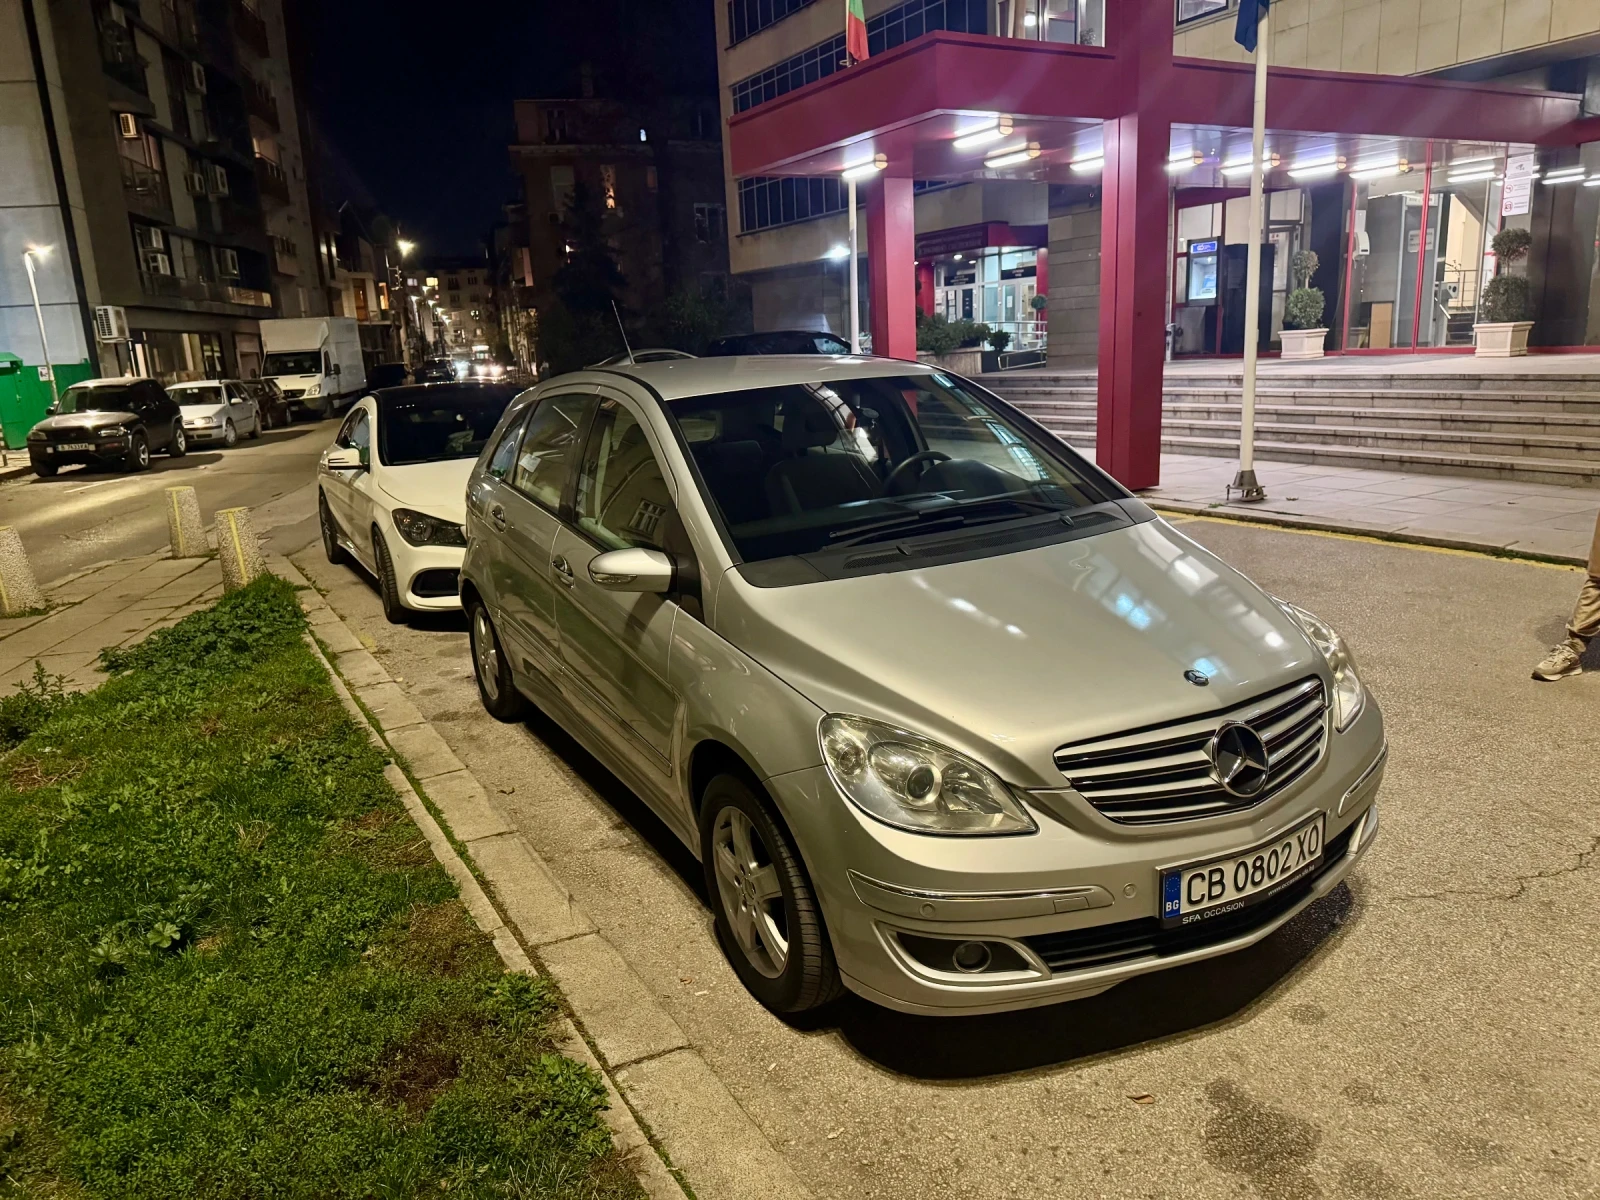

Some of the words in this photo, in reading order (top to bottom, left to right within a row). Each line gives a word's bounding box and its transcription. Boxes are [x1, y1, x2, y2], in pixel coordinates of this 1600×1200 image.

[1187, 867, 1226, 905] CB
[1233, 841, 1293, 892] 0802
[1295, 824, 1320, 866] XO
[1165, 901, 1179, 912] BG
[1182, 915, 1201, 925] SFA
[1203, 901, 1245, 919] OCCASION
